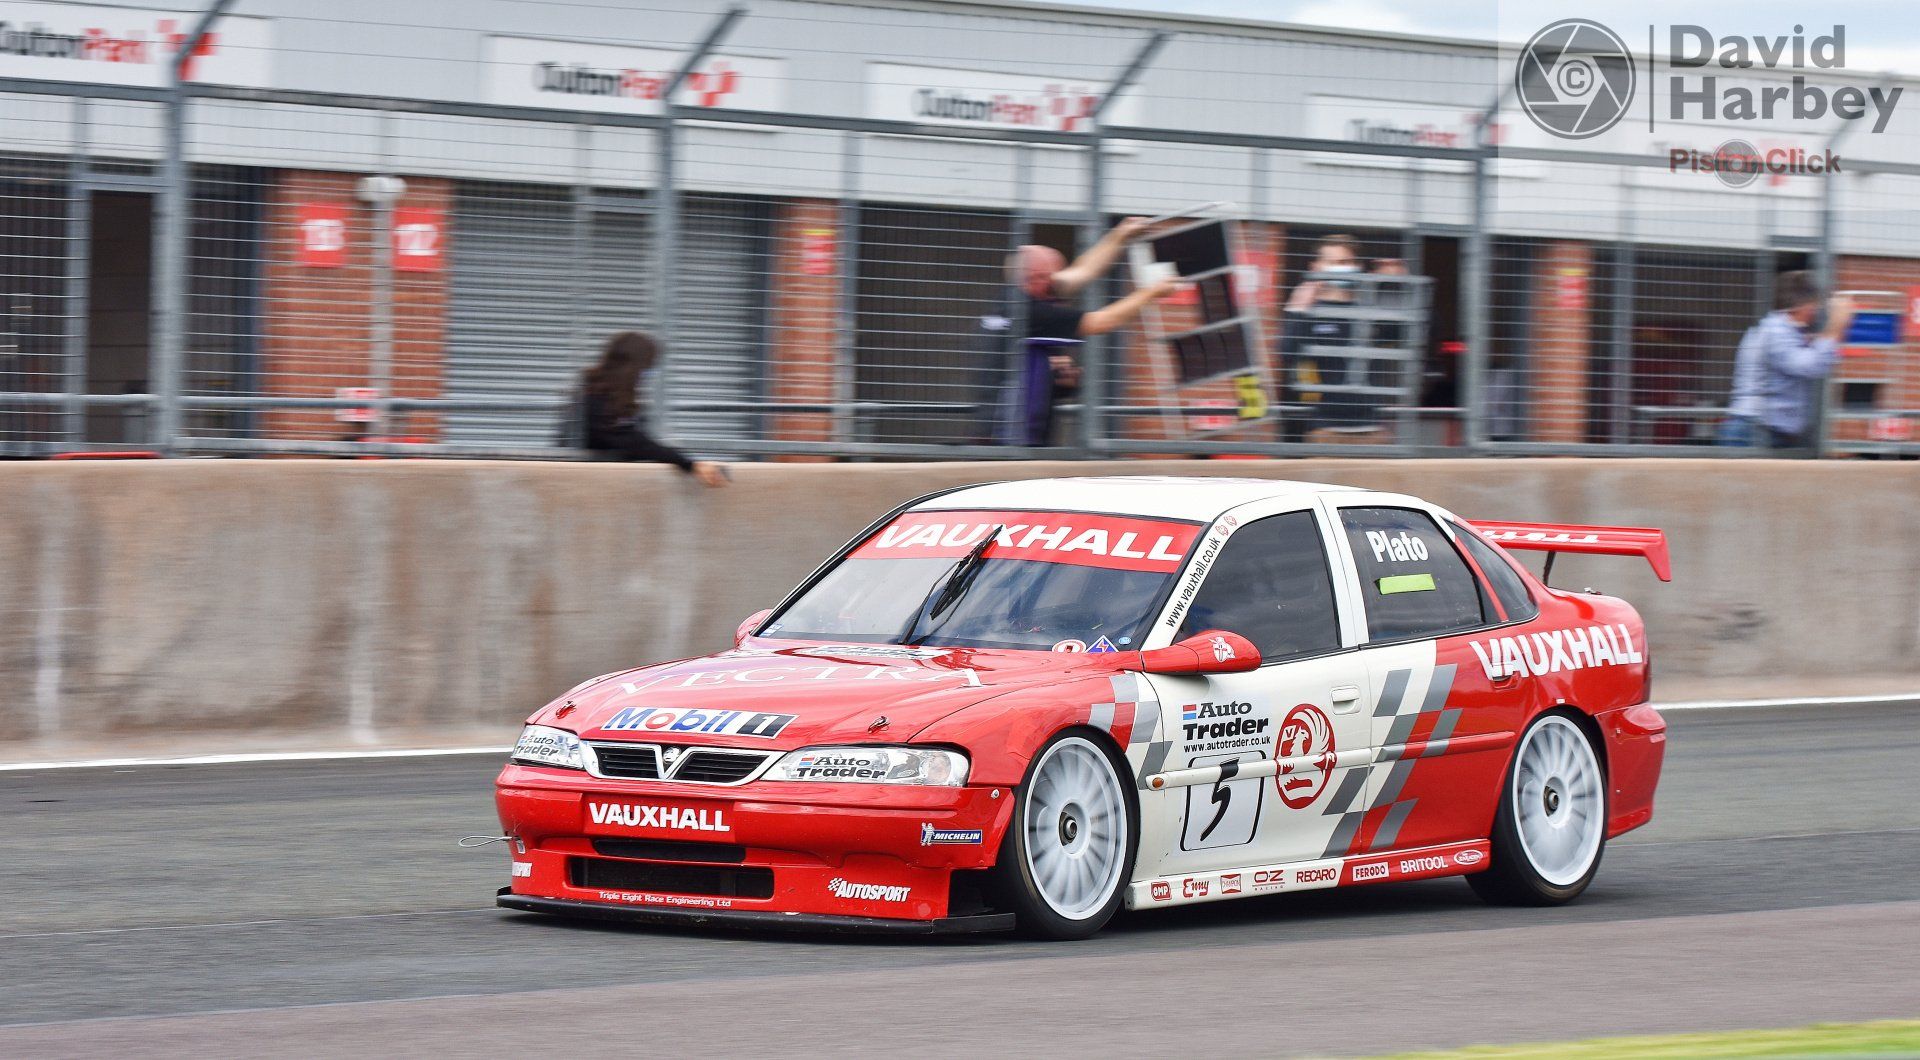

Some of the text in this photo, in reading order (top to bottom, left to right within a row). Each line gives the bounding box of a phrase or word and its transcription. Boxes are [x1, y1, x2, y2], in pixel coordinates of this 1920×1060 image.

[876, 523, 1184, 561] VAUXHALL
[1366, 530, 1429, 562] Plato
[1166, 537, 1221, 628] www.vauxhall.co.uk
[1470, 624, 1643, 680] VAUXHALL
[618, 665, 989, 694] VECTRA
[1198, 701, 1252, 719] Auto
[604, 708, 742, 733] Mobil
[1183, 717, 1269, 740] Trader
[525, 734, 554, 745] Auto
[1184, 736, 1271, 752] www.autotrader.co.uk
[814, 756, 871, 766] Auto
[797, 767, 887, 779] Trader
[1200, 757, 1239, 841] 5
[589, 802, 730, 832] VAUXHALL
[933, 832, 981, 840] MICHELIN
[1355, 865, 1386, 879] FERODO
[1401, 856, 1449, 874] BRITOOL
[1297, 868, 1337, 883] RECARO
[599, 892, 731, 907] Triple Eight Race Engineering Ltd
[835, 880, 911, 902] AUTOSPORT
